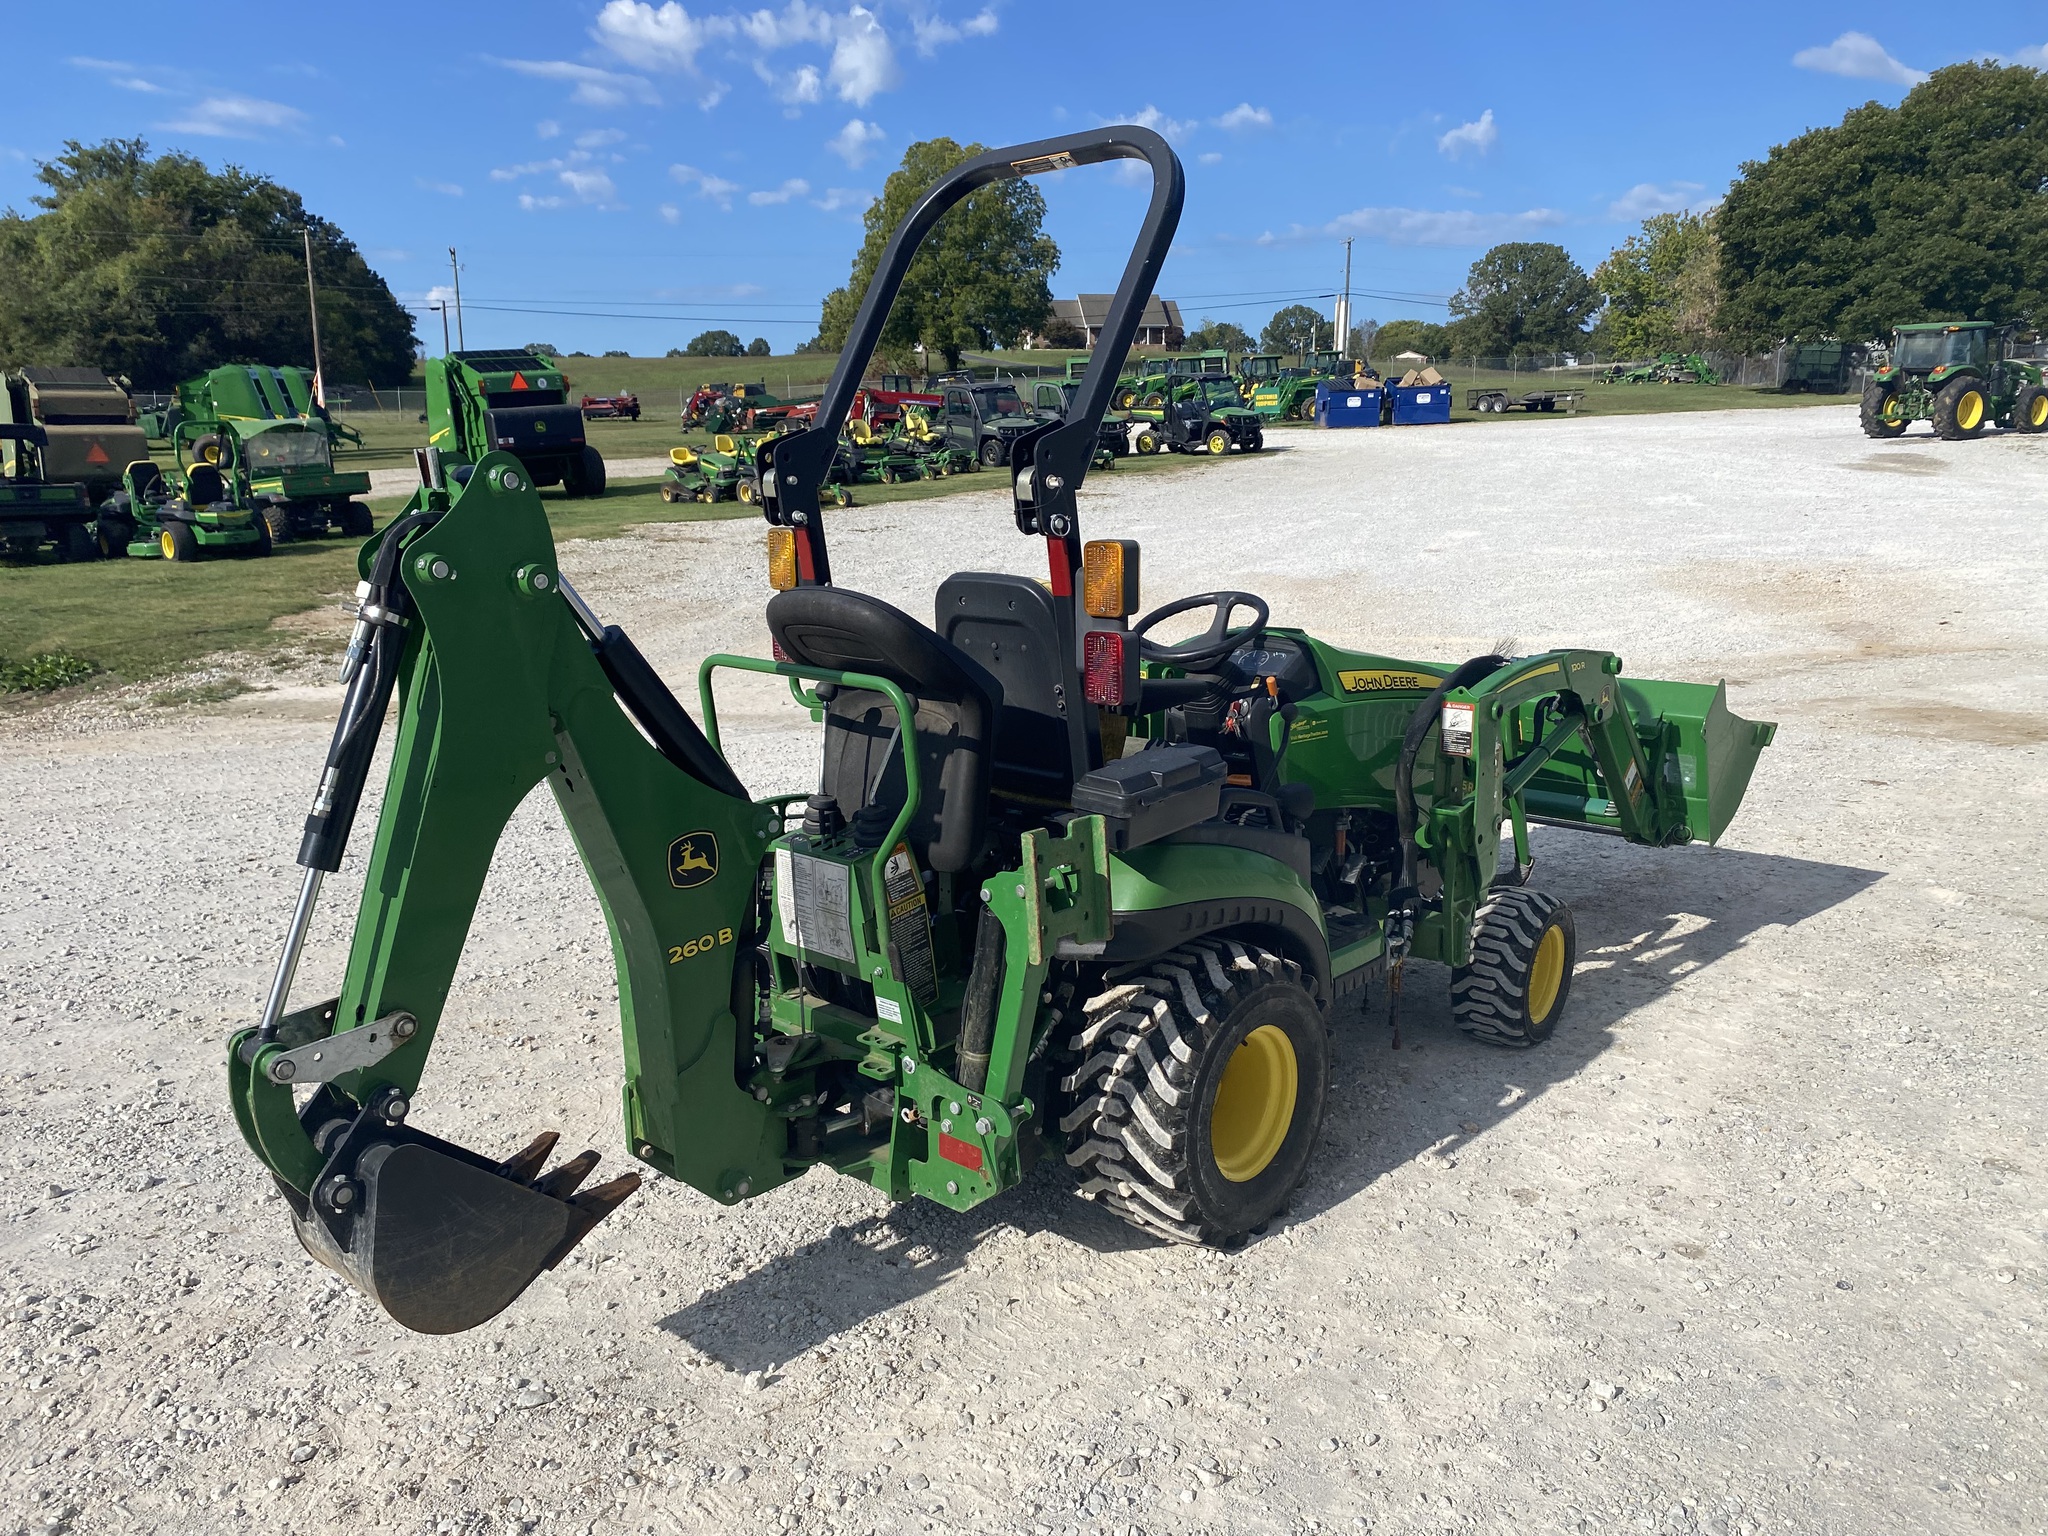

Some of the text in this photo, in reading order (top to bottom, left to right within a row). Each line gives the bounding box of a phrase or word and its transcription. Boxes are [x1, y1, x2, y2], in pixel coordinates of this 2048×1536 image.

[1351, 674, 1420, 691] JOHN DEERE
[896, 898, 922, 914] CAUTION
[668, 933, 715, 965] 260
[718, 926, 734, 946] B
